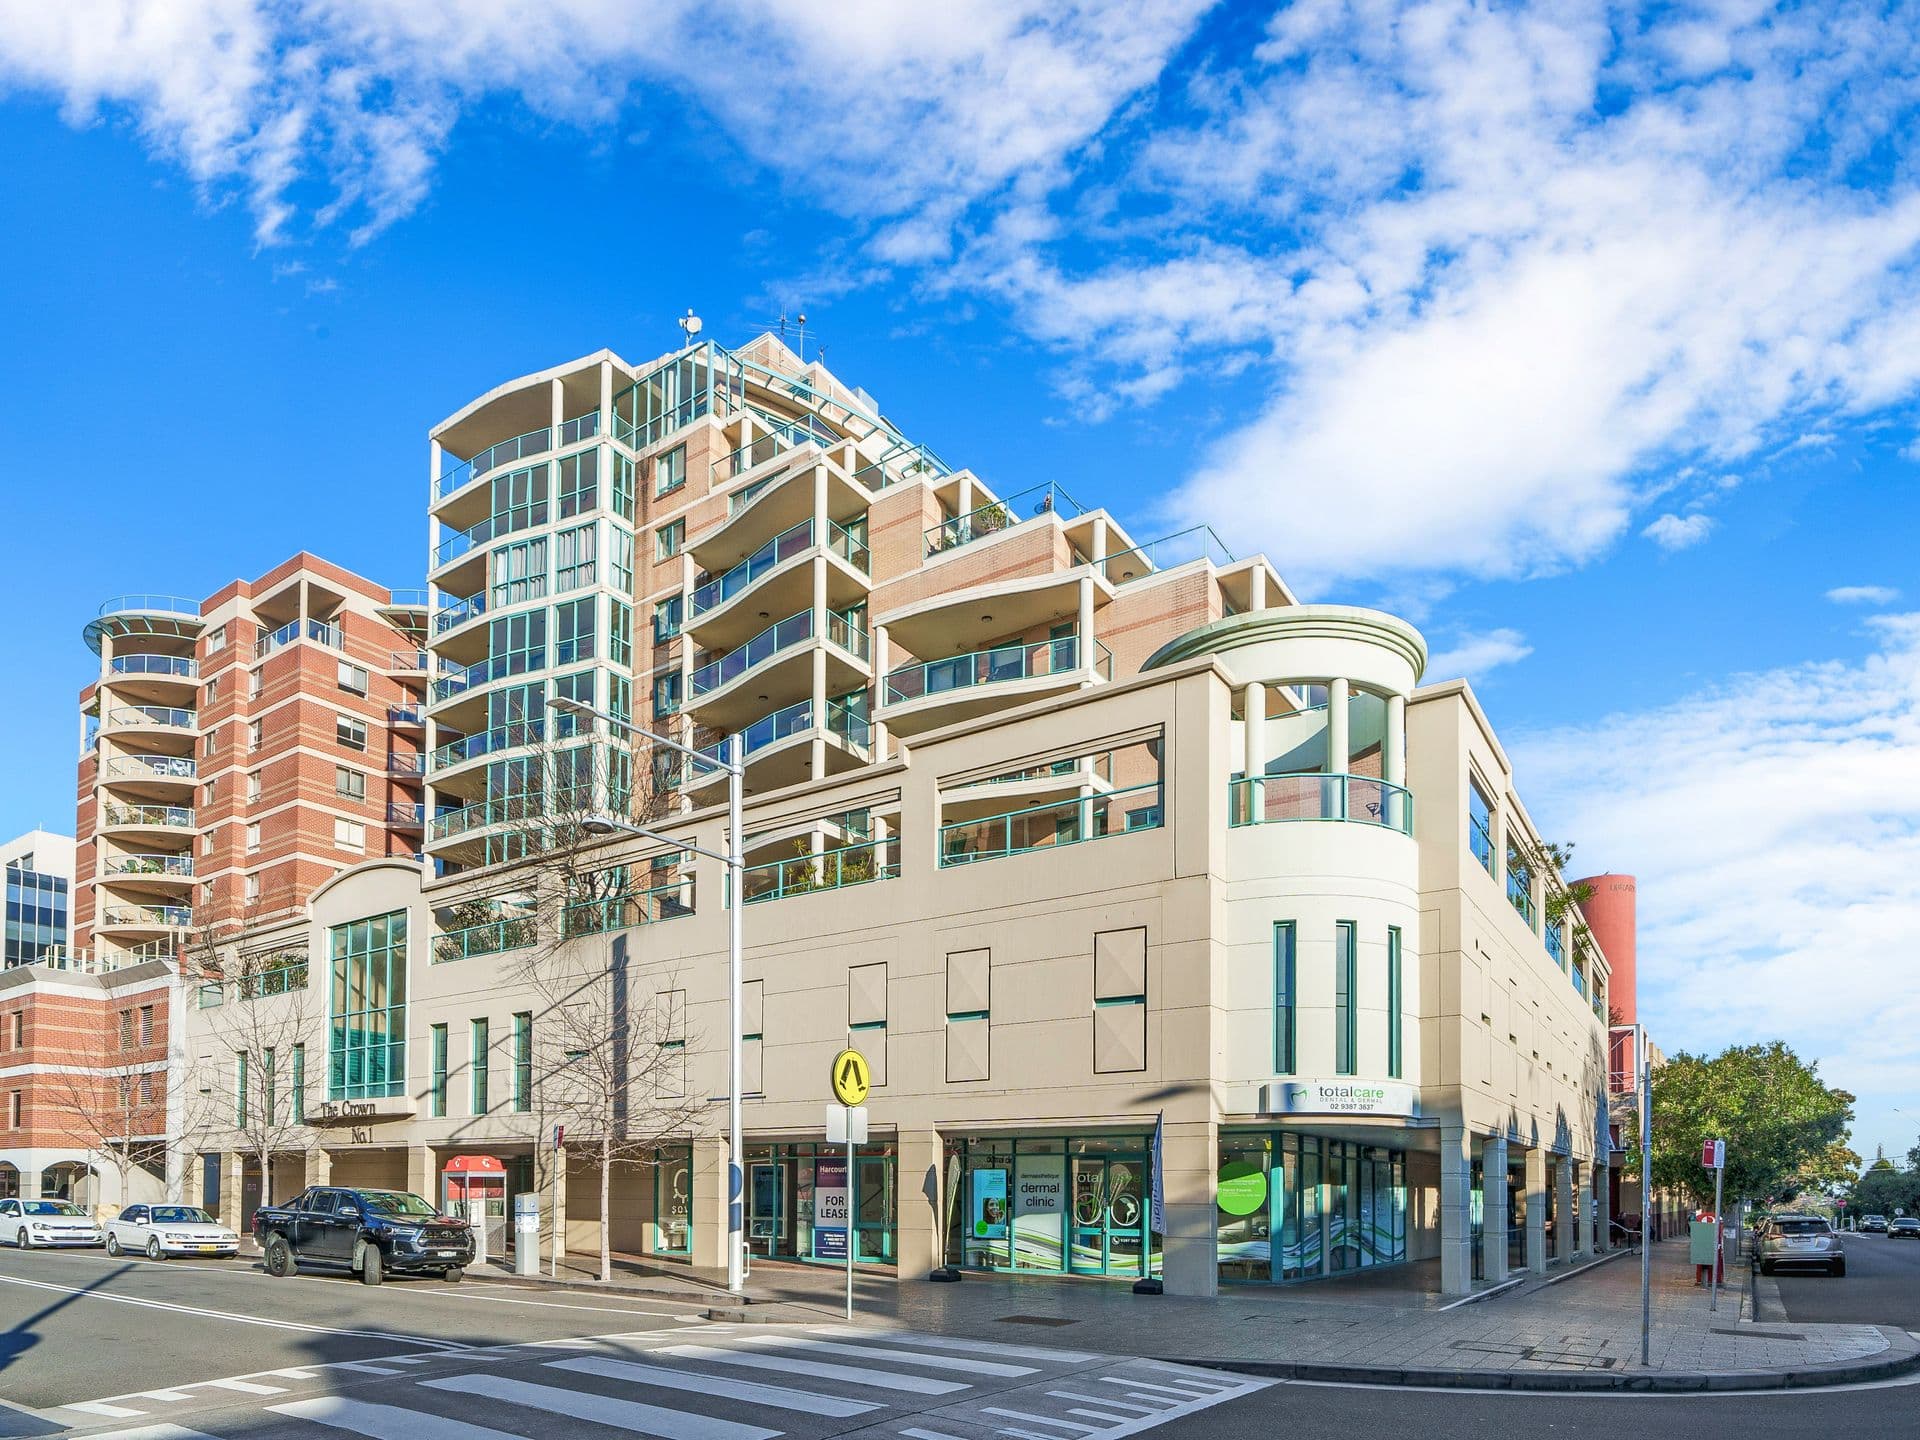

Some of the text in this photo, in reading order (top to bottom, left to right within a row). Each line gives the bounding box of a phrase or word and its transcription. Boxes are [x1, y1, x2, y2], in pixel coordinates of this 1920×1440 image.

[1319, 1086, 1384, 1099] totalcare
[320, 1100, 376, 1118] The Crown
[1021, 1183, 1060, 1193] dermal
[825, 1196, 845, 1206] FOR
[1025, 1196, 1055, 1207] clinic
[820, 1208, 849, 1219] LEASE
